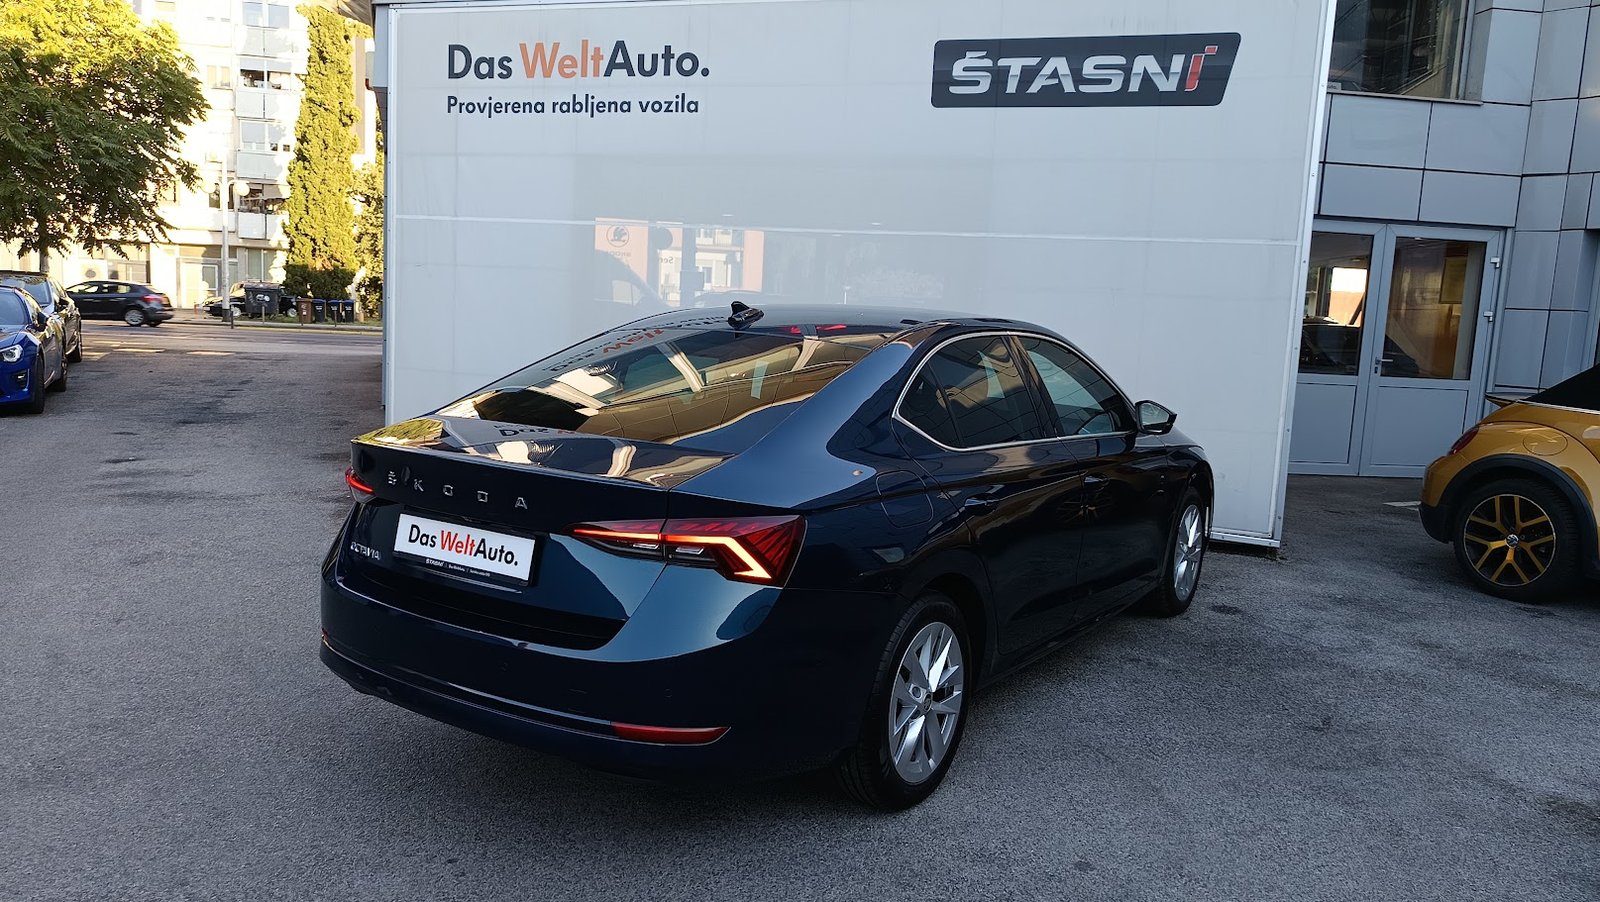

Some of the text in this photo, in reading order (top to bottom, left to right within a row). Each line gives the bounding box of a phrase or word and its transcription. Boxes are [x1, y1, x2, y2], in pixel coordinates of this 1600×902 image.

[447, 44, 513, 80] Das
[447, 92, 699, 118] Provjerena rabljena vozila
[408, 524, 437, 548] Das
[350, 541, 381, 561] OCTAVIA
